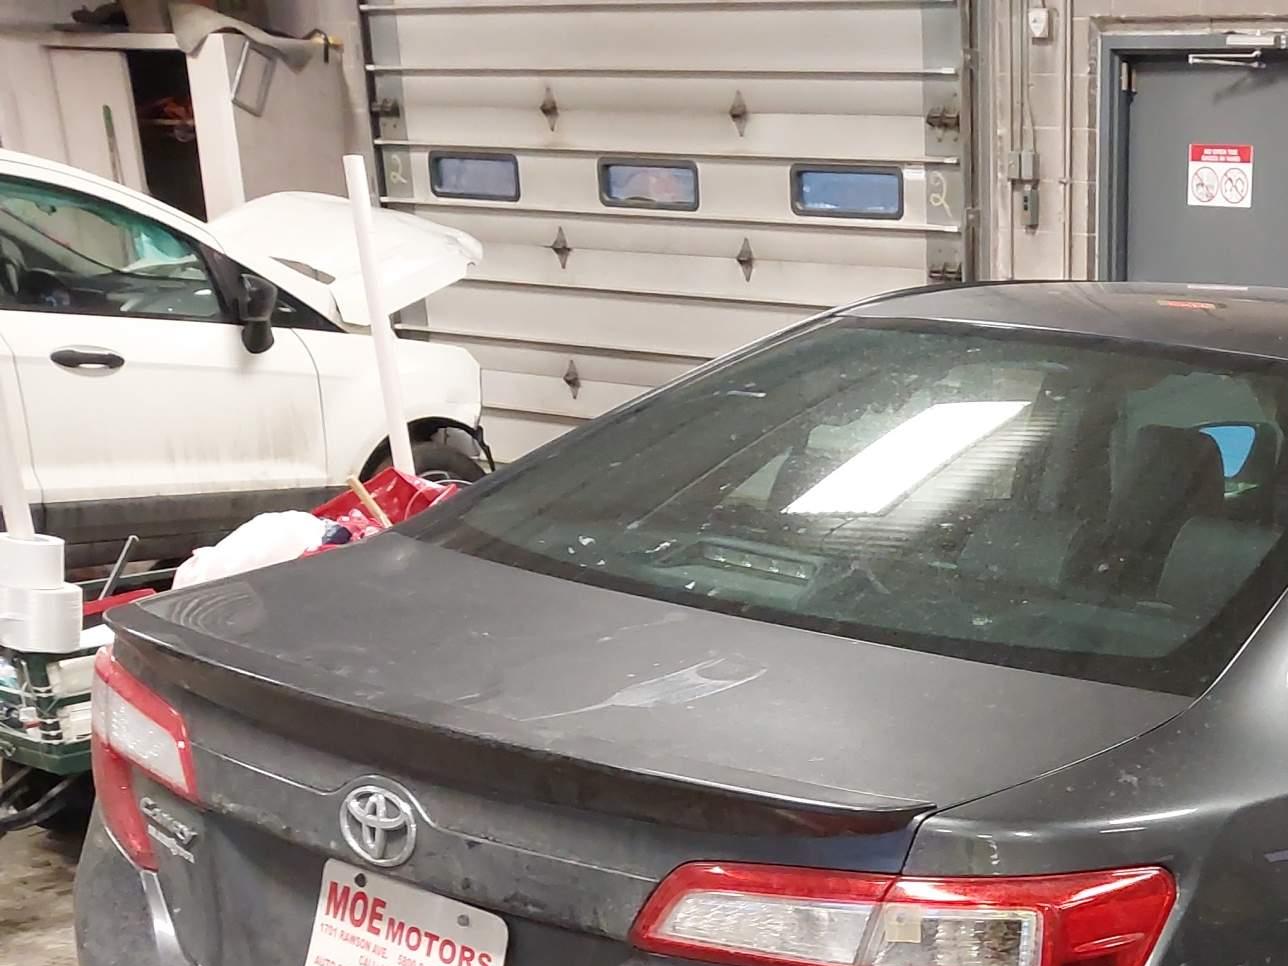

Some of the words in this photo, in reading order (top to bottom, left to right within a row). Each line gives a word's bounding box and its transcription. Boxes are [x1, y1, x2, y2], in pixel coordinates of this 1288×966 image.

[930, 171, 953, 218] 2
[325, 881, 387, 936] MOE
[371, 943, 388, 959] AVE.
